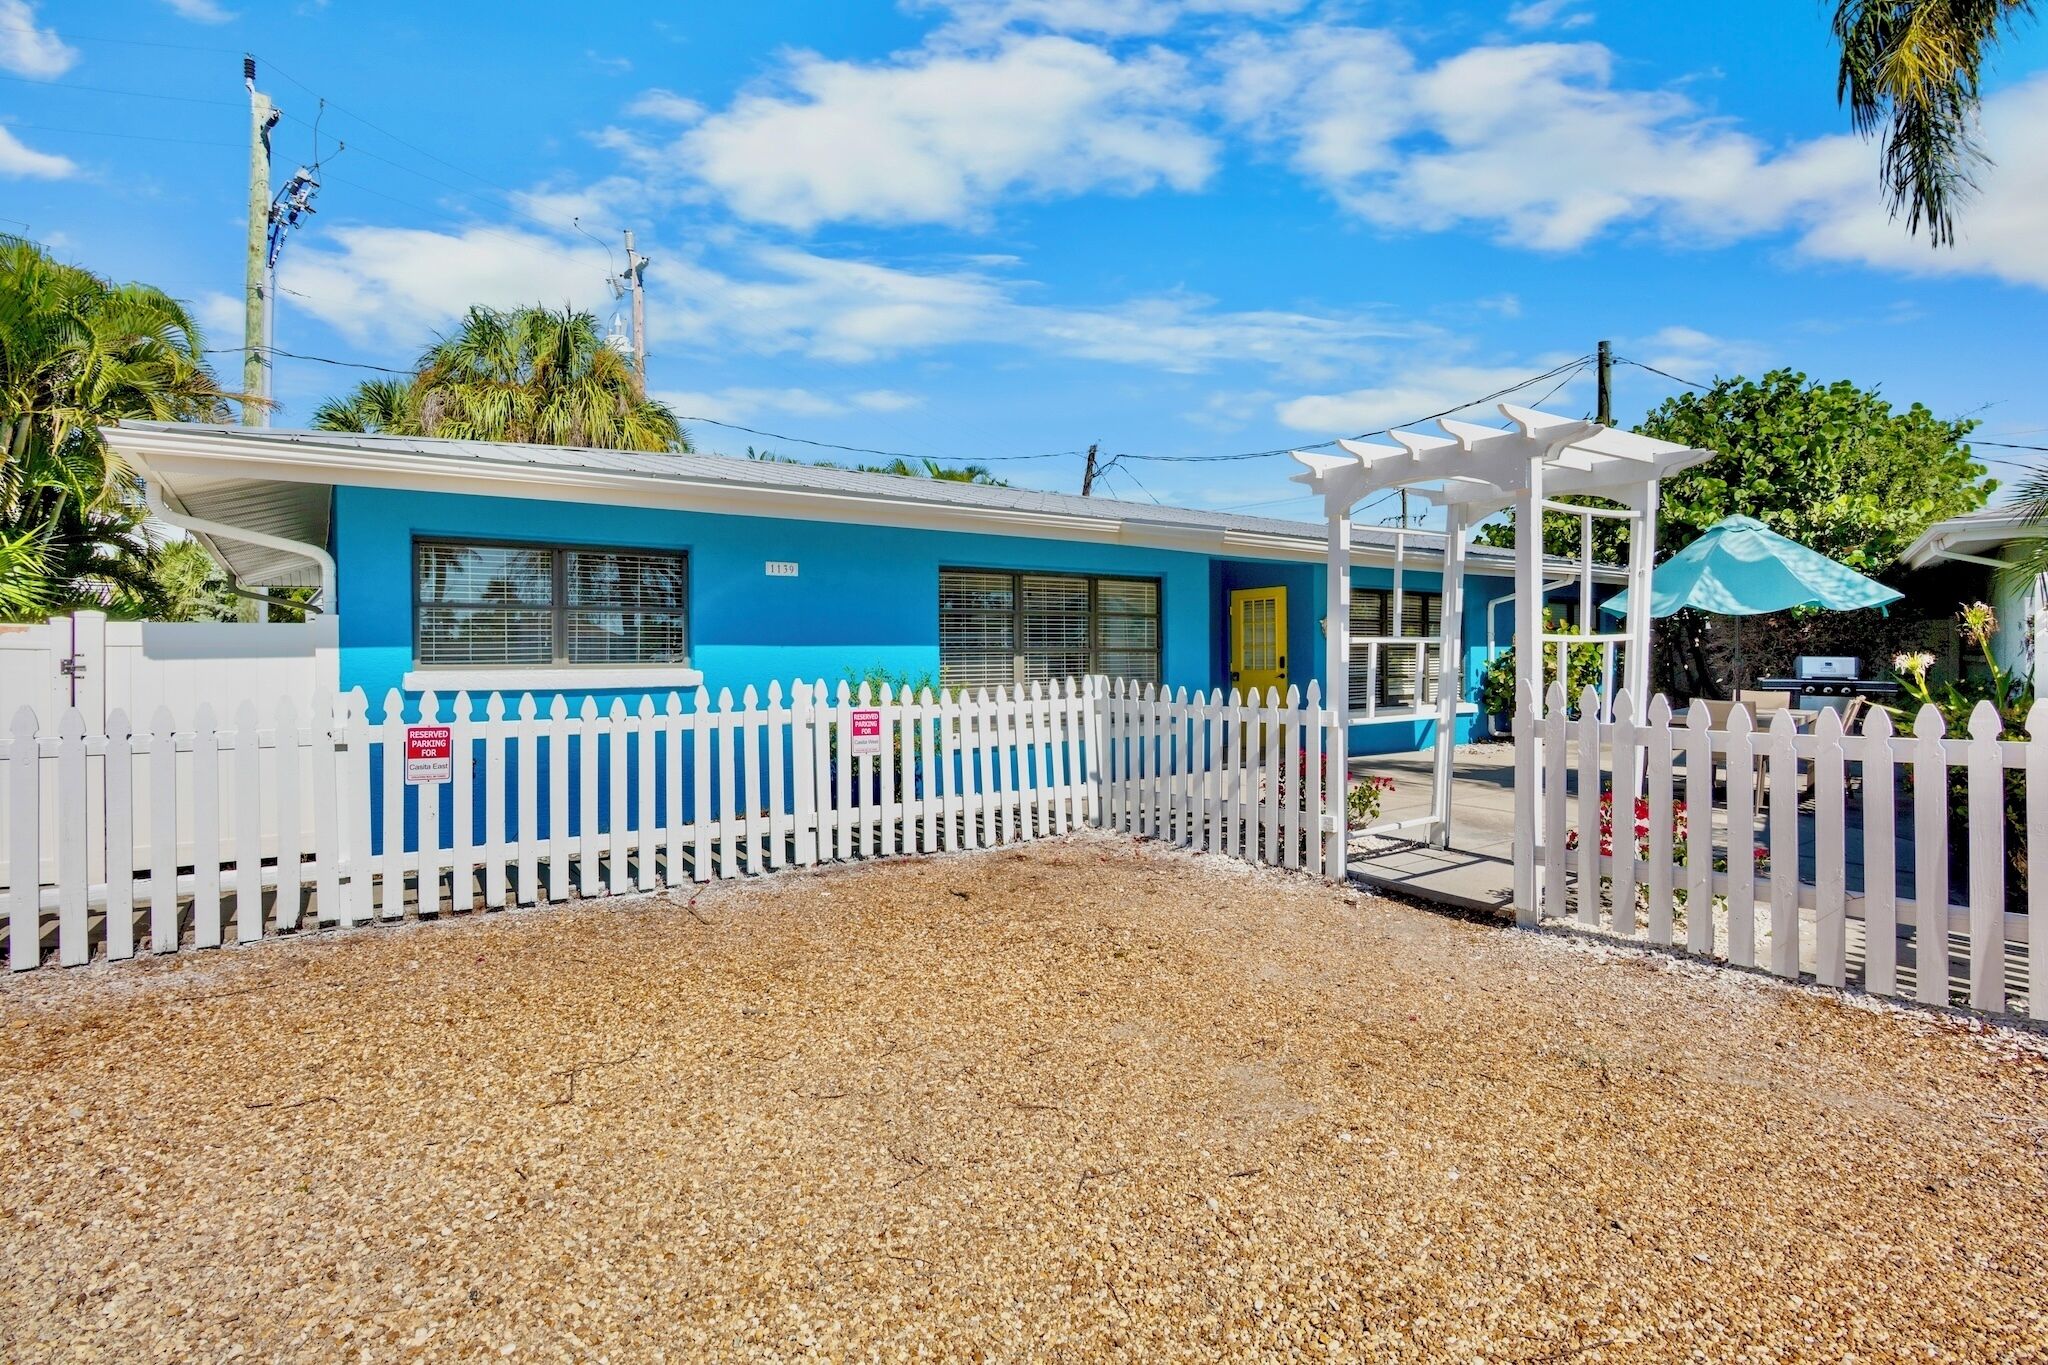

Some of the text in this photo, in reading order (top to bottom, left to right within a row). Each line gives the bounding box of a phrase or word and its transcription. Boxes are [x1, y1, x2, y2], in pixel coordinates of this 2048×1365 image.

[409, 731, 448, 739] RESERVED
[412, 740, 446, 748] PARKING
[422, 749, 437, 757] FOR
